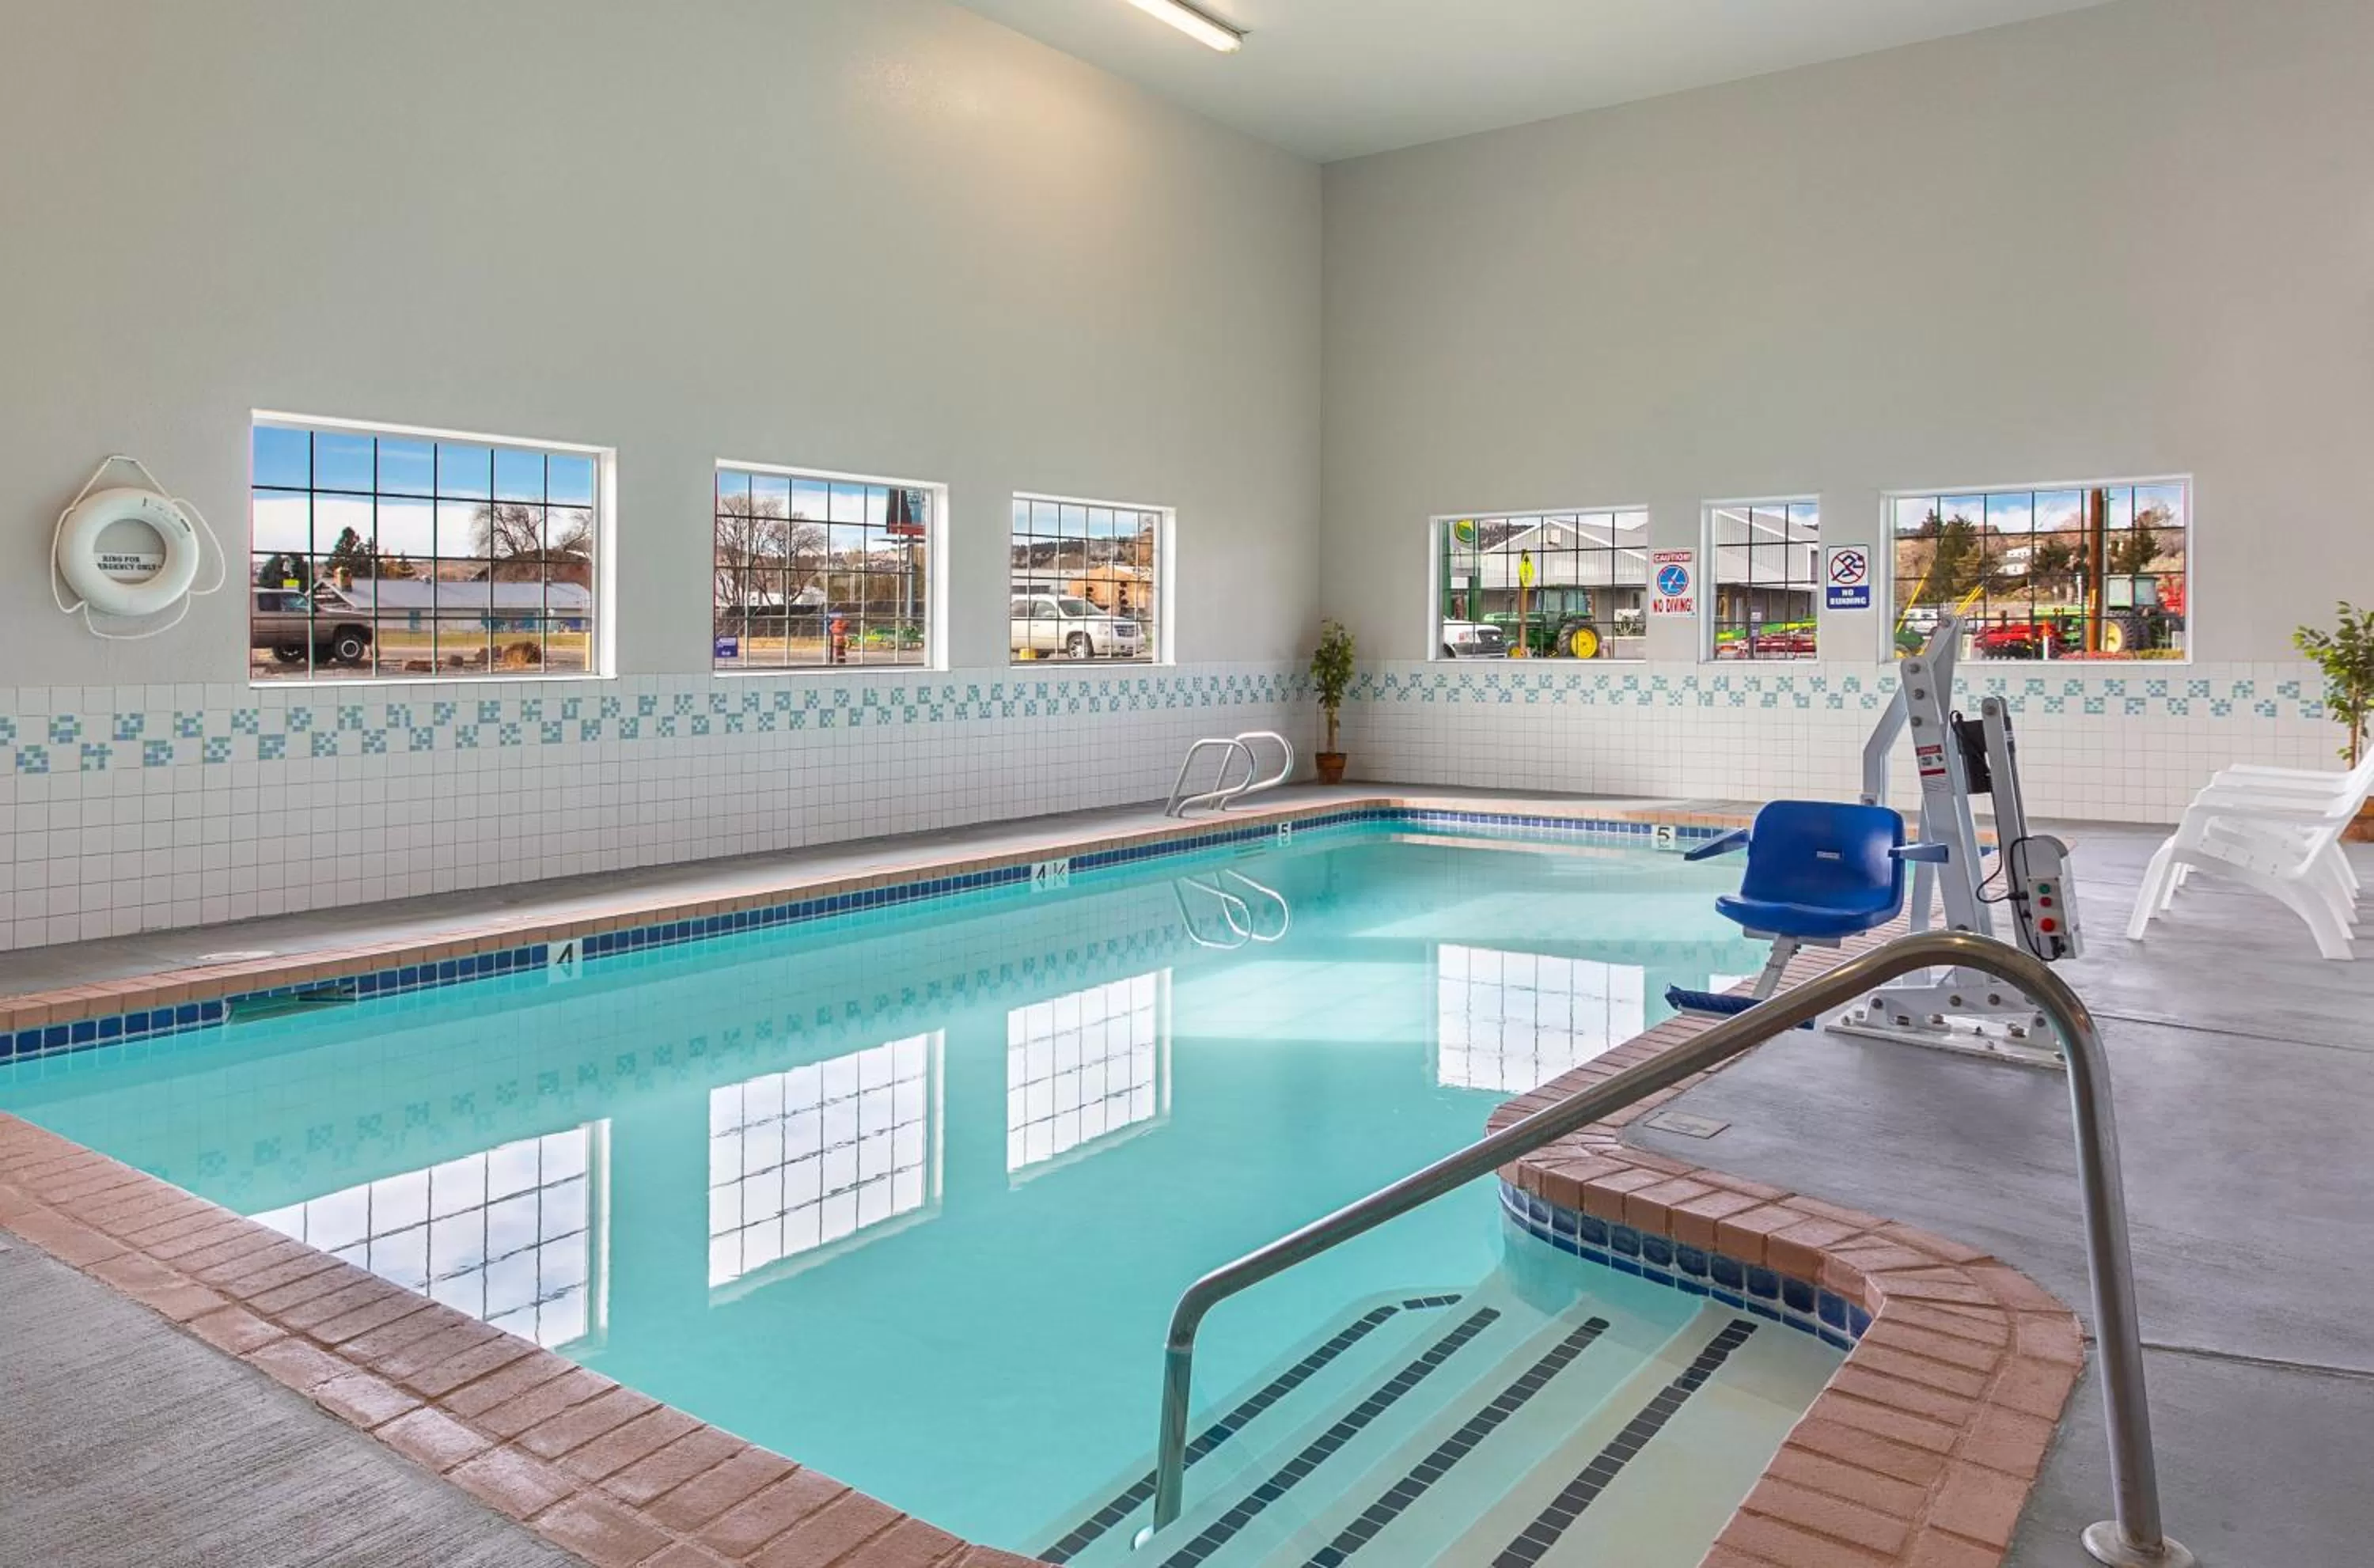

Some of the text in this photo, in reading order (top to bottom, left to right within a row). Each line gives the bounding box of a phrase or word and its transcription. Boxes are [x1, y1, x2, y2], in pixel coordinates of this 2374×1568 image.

[1653, 599, 1663, 612] NO
[1657, 827, 1671, 839] 5
[1036, 864, 1046, 879] 4
[556, 942, 574, 964] 4
